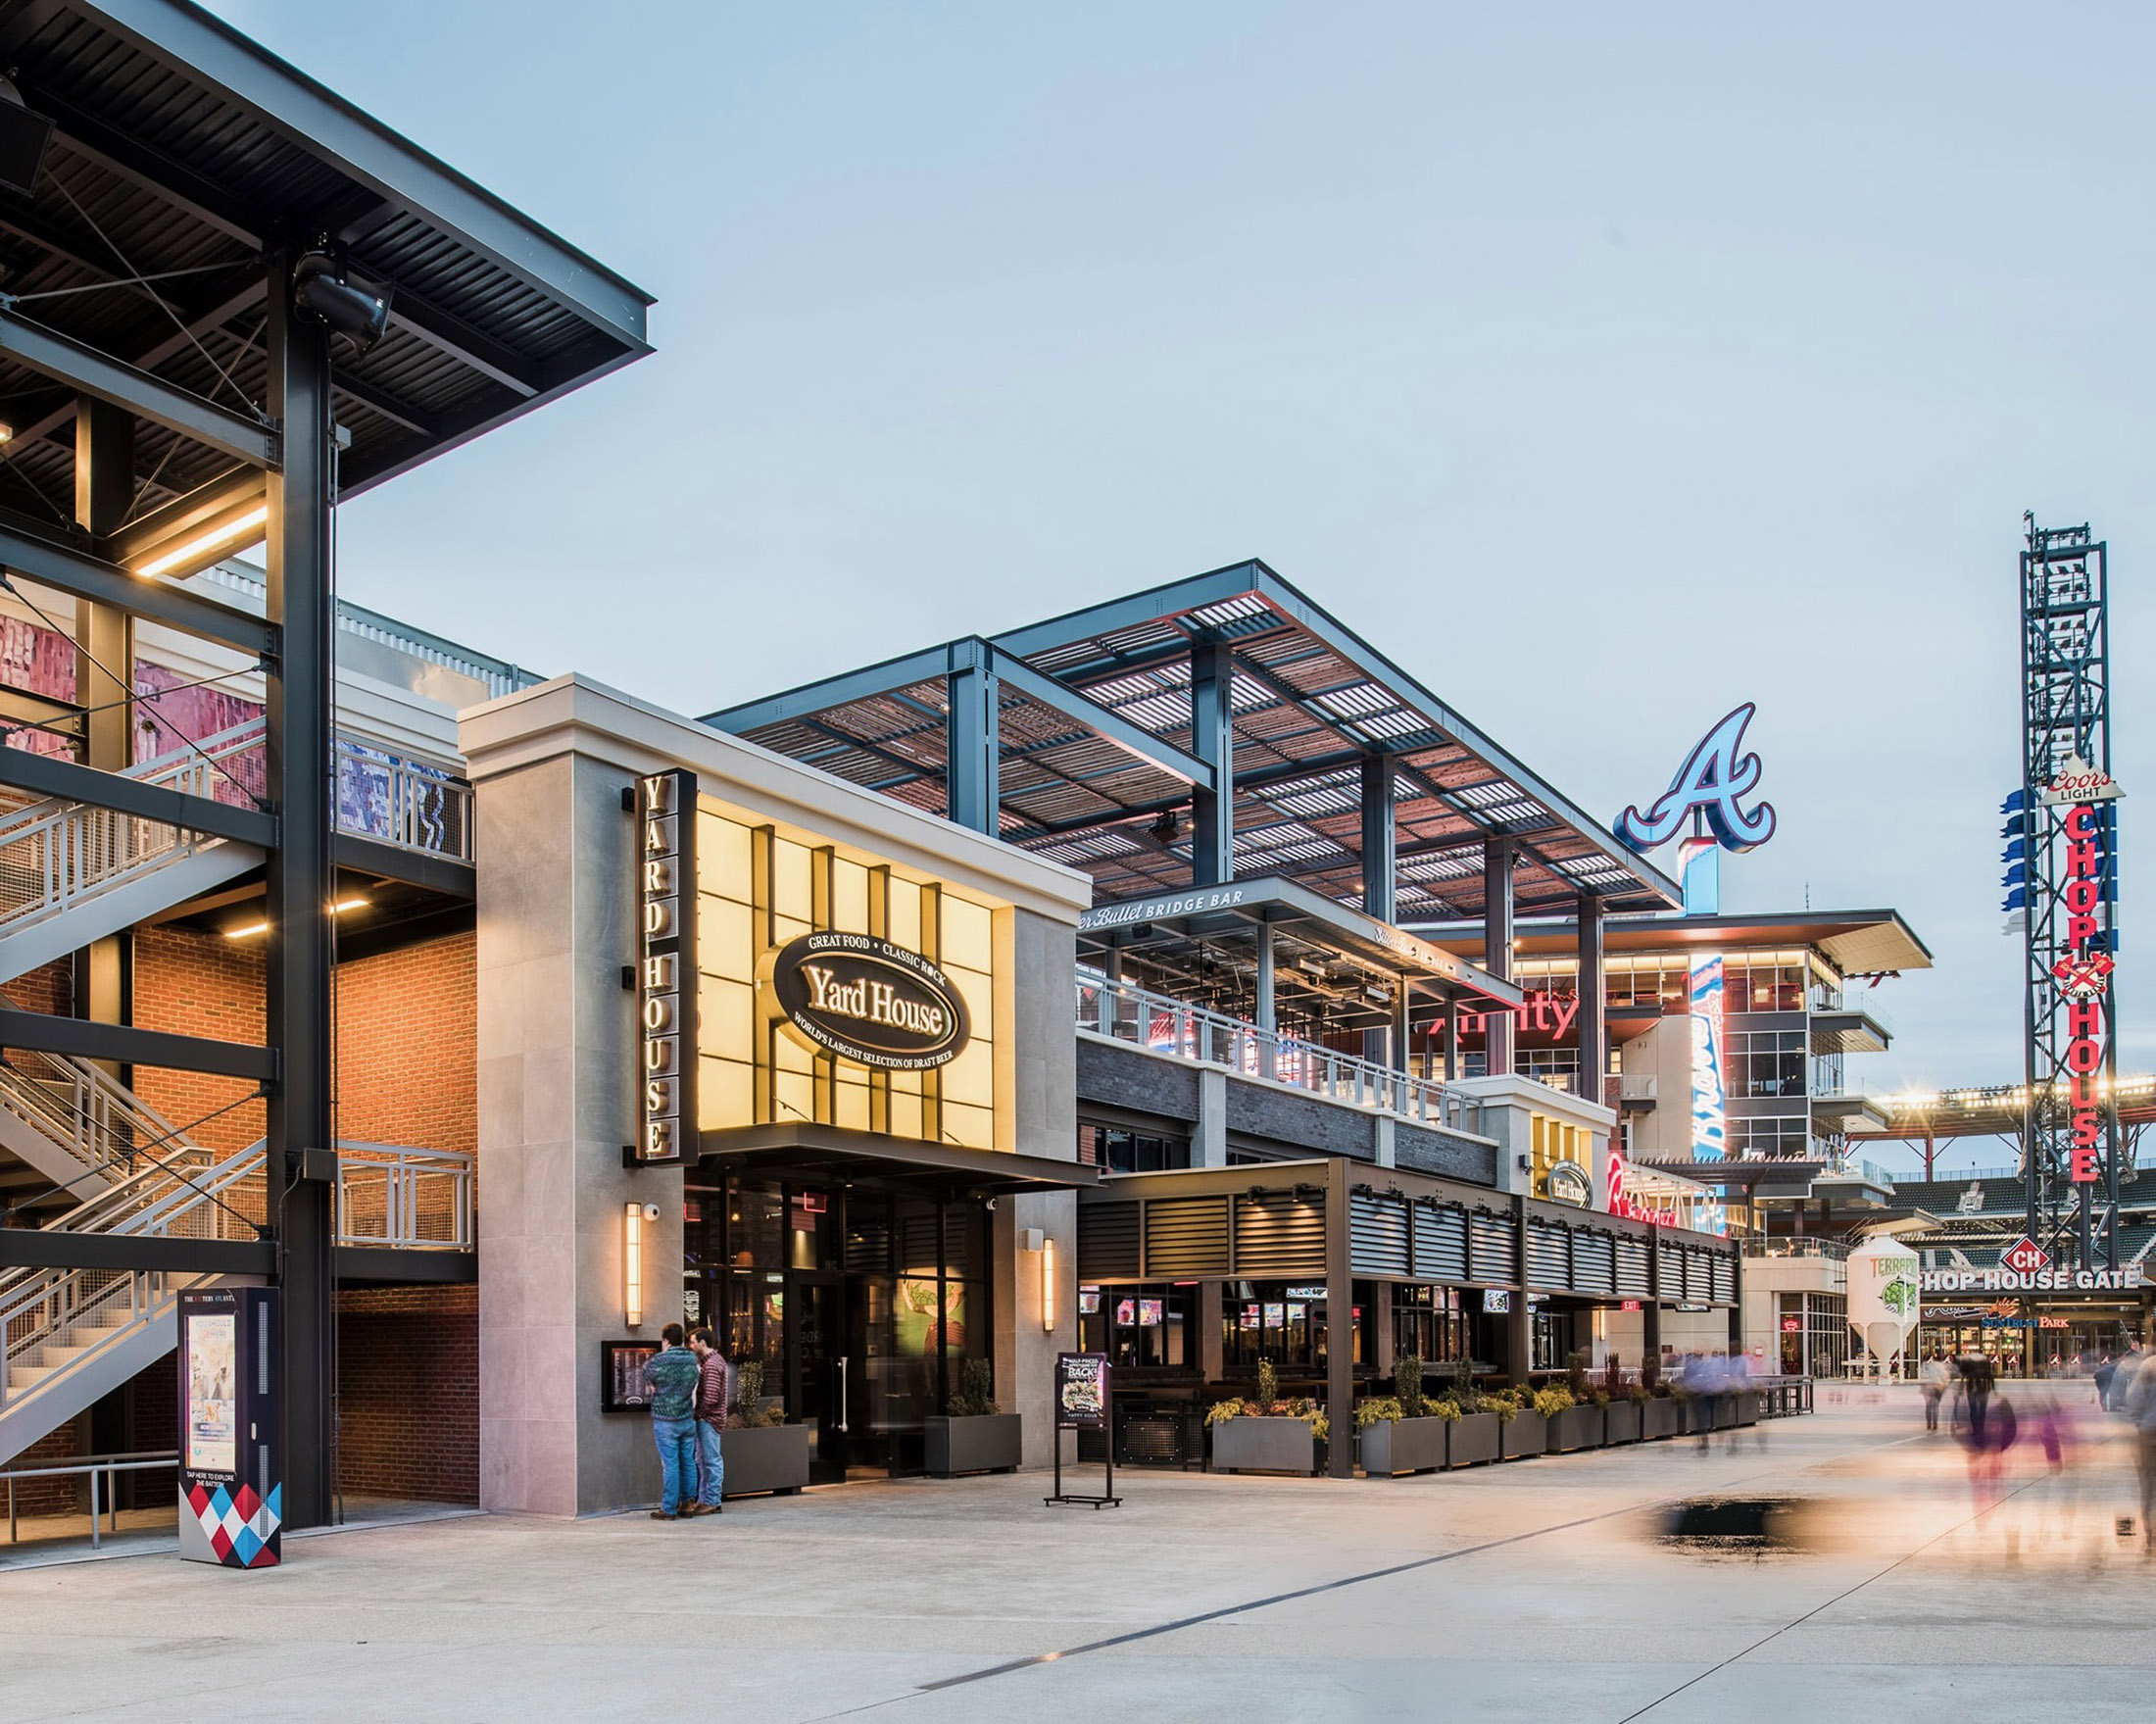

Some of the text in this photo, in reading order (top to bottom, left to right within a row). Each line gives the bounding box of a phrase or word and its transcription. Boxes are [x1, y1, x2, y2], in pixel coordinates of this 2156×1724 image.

[1617, 702, 1776, 849] A
[2049, 770, 2110, 792] Coors
[2061, 786, 2100, 800] LIGHT
[2066, 806, 2098, 949] CHOP
[1094, 903, 1144, 927] Bullet
[1146, 897, 1204, 917] BRIDGE
[1210, 891, 1243, 907] BAR
[644, 776, 667, 1154] YARD HOUSE
[808, 935, 946, 987] GREAT FOOD CLASSIC ROCK
[807, 964, 944, 1036] Yard House
[794, 1011, 954, 1068] WORLD'S LARGEST SELECTION OF DRAFT BEER
[2068, 1002, 2100, 1182] HOUSE
[1553, 1177, 1567, 1198] Yard
[2013, 1251, 2040, 1269] CH
[1984, 1272, 2069, 1291] HOUSE
[2076, 1271, 2140, 1290] GATE
[1624, 1301, 1637, 1310] EXIT
[2038, 1316, 2070, 1328] PARK
[215, 1473, 234, 1482] EXPLORE
